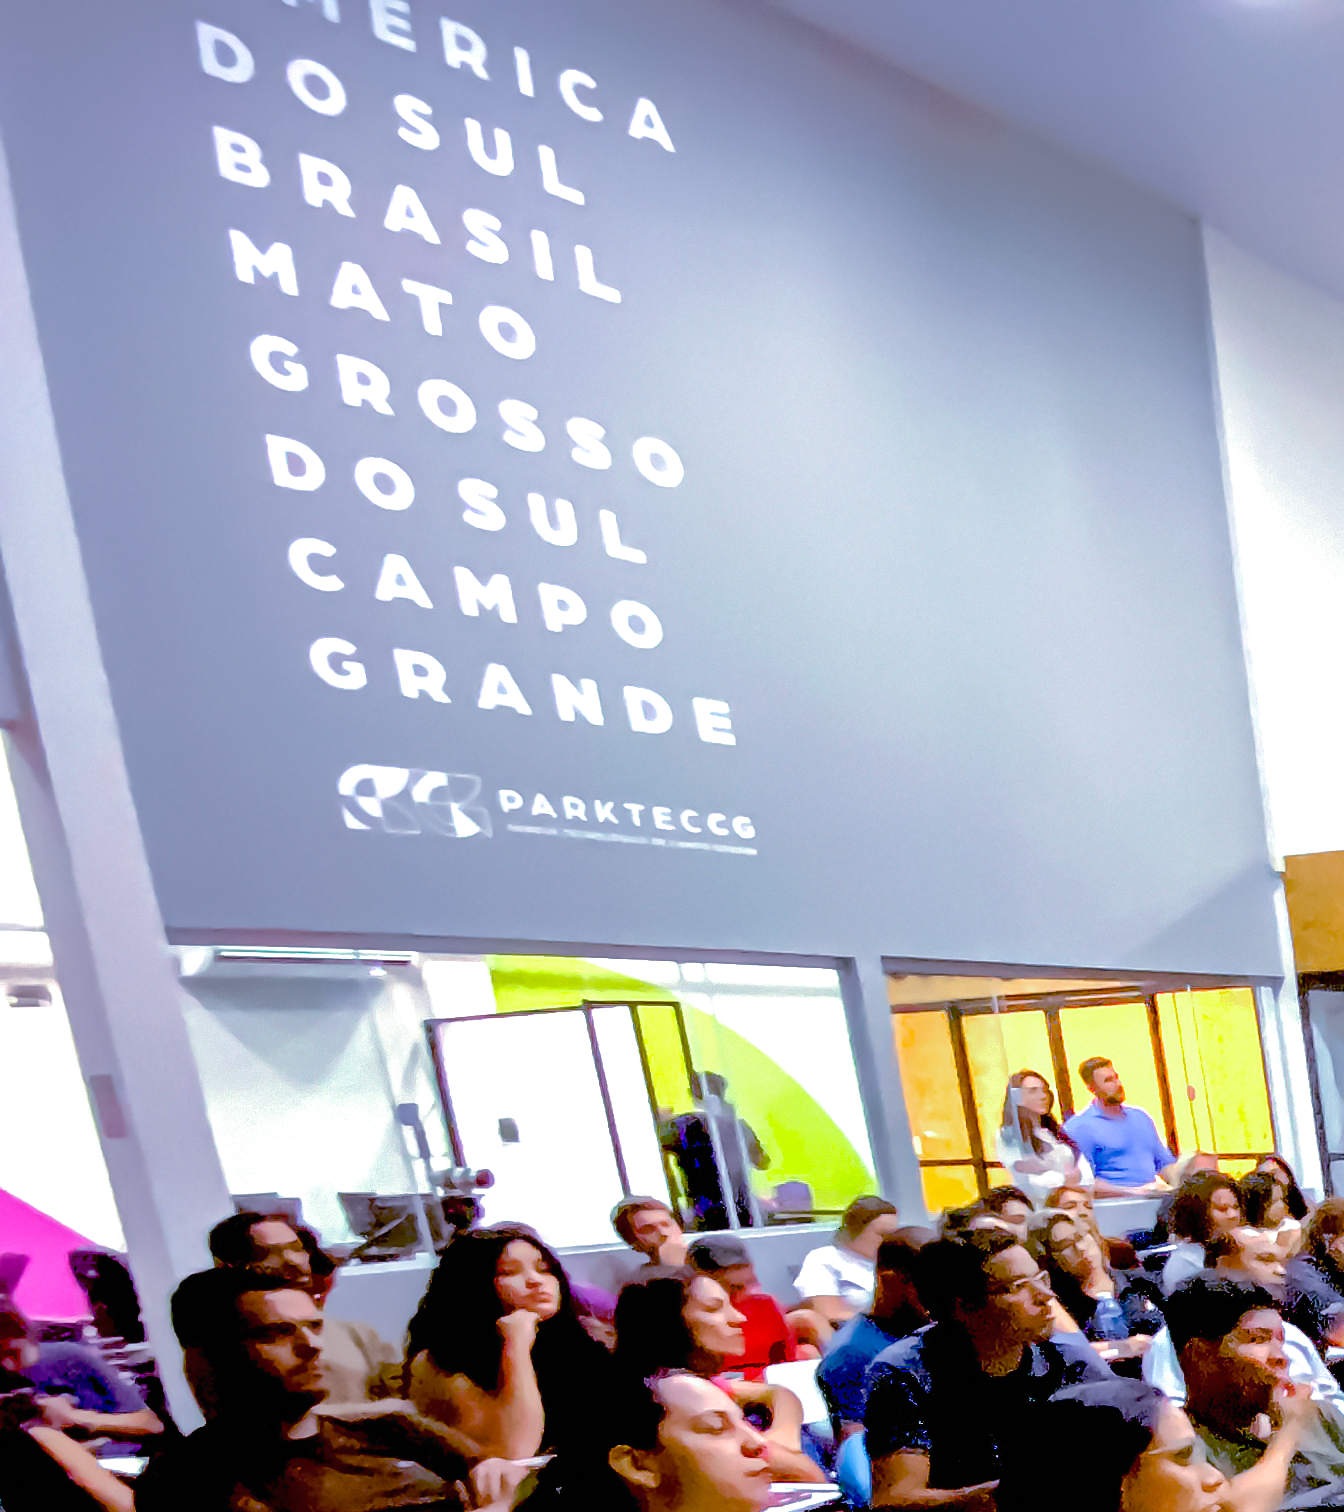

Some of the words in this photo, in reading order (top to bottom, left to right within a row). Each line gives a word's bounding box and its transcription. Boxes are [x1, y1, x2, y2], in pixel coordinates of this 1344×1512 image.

[195, 19, 348, 117] DO
[392, 93, 586, 206] SUL
[212, 125, 623, 304] BRASIL
[228, 228, 537, 360] MATO
[249, 334, 686, 489] GROSSO
[265, 433, 416, 511] DO
[457, 477, 648, 565] SUL
[287, 537, 665, 650] CAMPO
[309, 637, 738, 746] GRANDE
[498, 788, 758, 839] PARKTECCG
